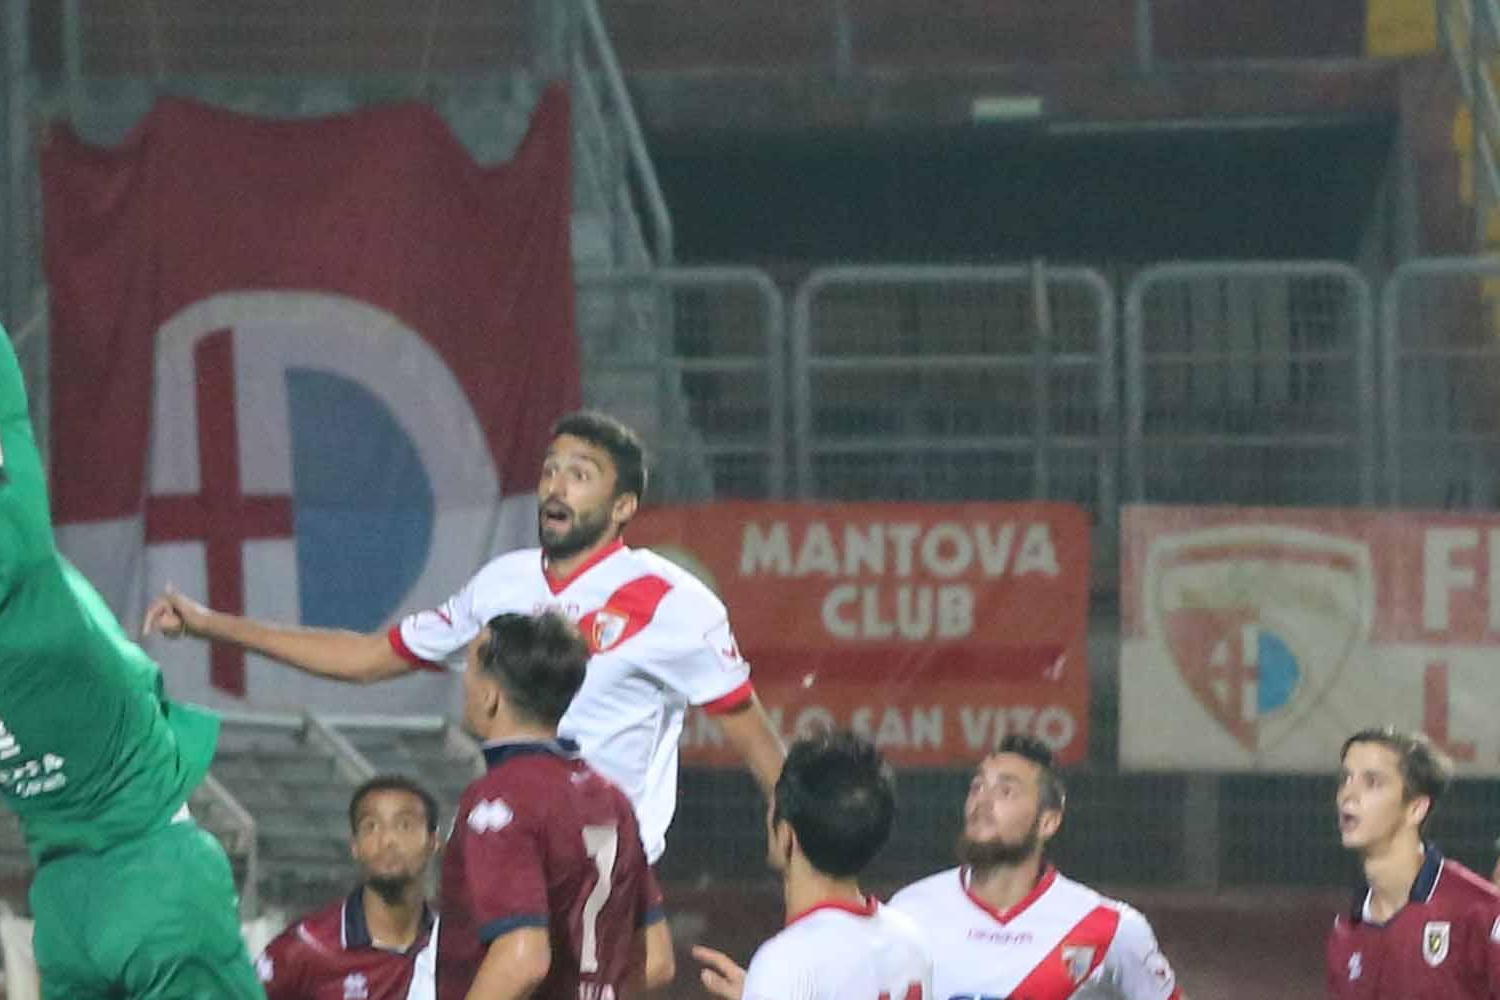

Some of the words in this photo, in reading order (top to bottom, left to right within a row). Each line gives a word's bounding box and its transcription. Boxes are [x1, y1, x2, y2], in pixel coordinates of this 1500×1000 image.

[740, 521, 1060, 578] MANTOVA
[1423, 526, 1500, 631] F
[820, 584, 976, 640] CLUB
[851, 704, 944, 749] SAN
[959, 705, 1076, 751] VITO
[580, 824, 618, 974] 7
